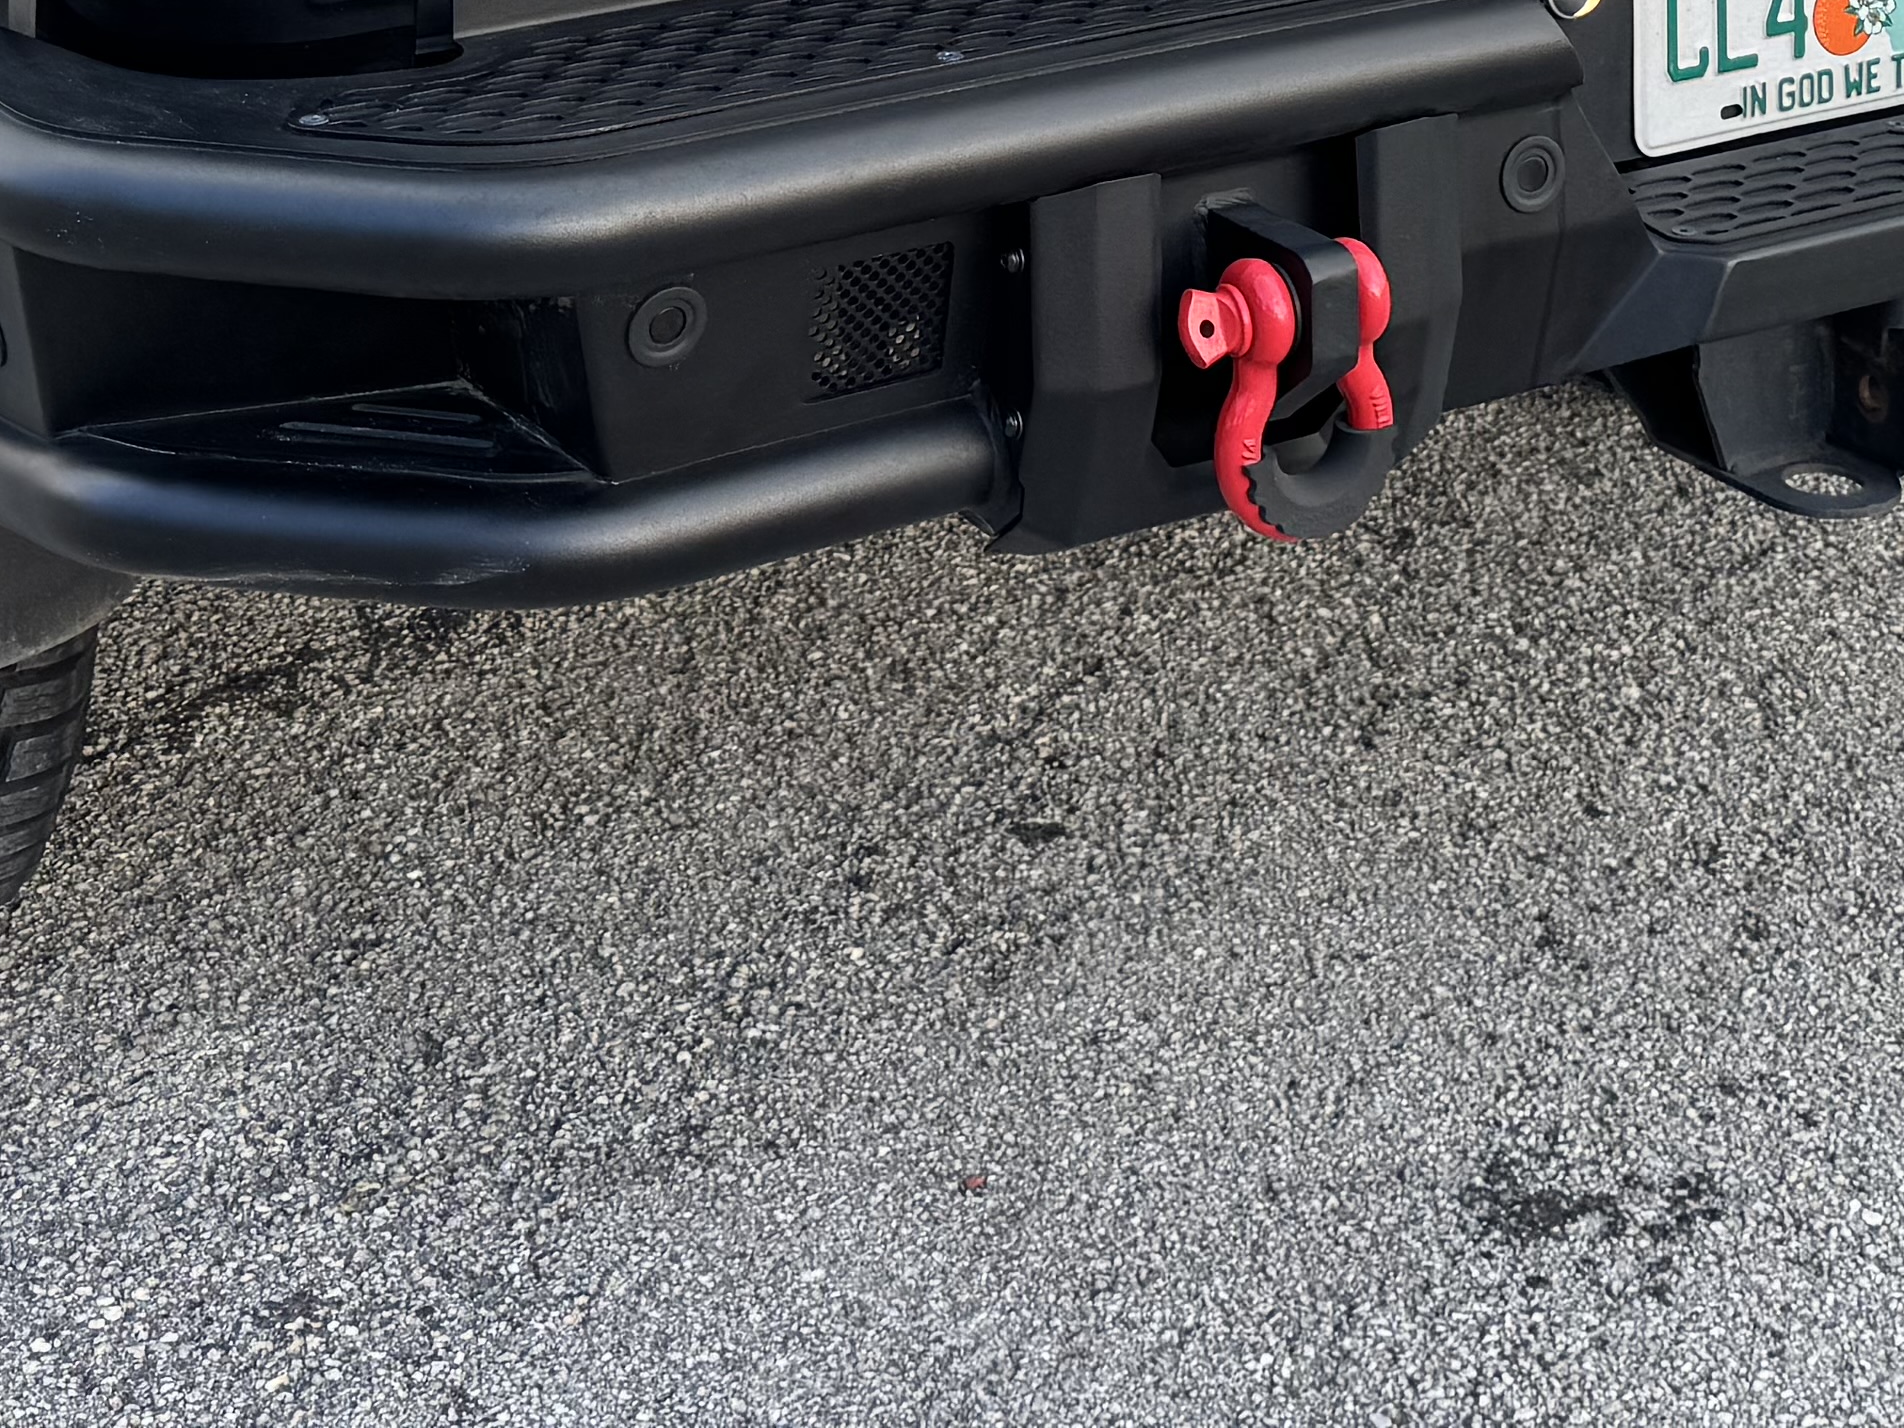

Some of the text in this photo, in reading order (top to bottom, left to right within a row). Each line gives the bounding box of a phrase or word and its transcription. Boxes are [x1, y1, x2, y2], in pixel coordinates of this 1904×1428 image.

[1740, 80, 1768, 120] IN
[1776, 66, 1835, 114] GOD
[1843, 56, 1882, 98] WE
